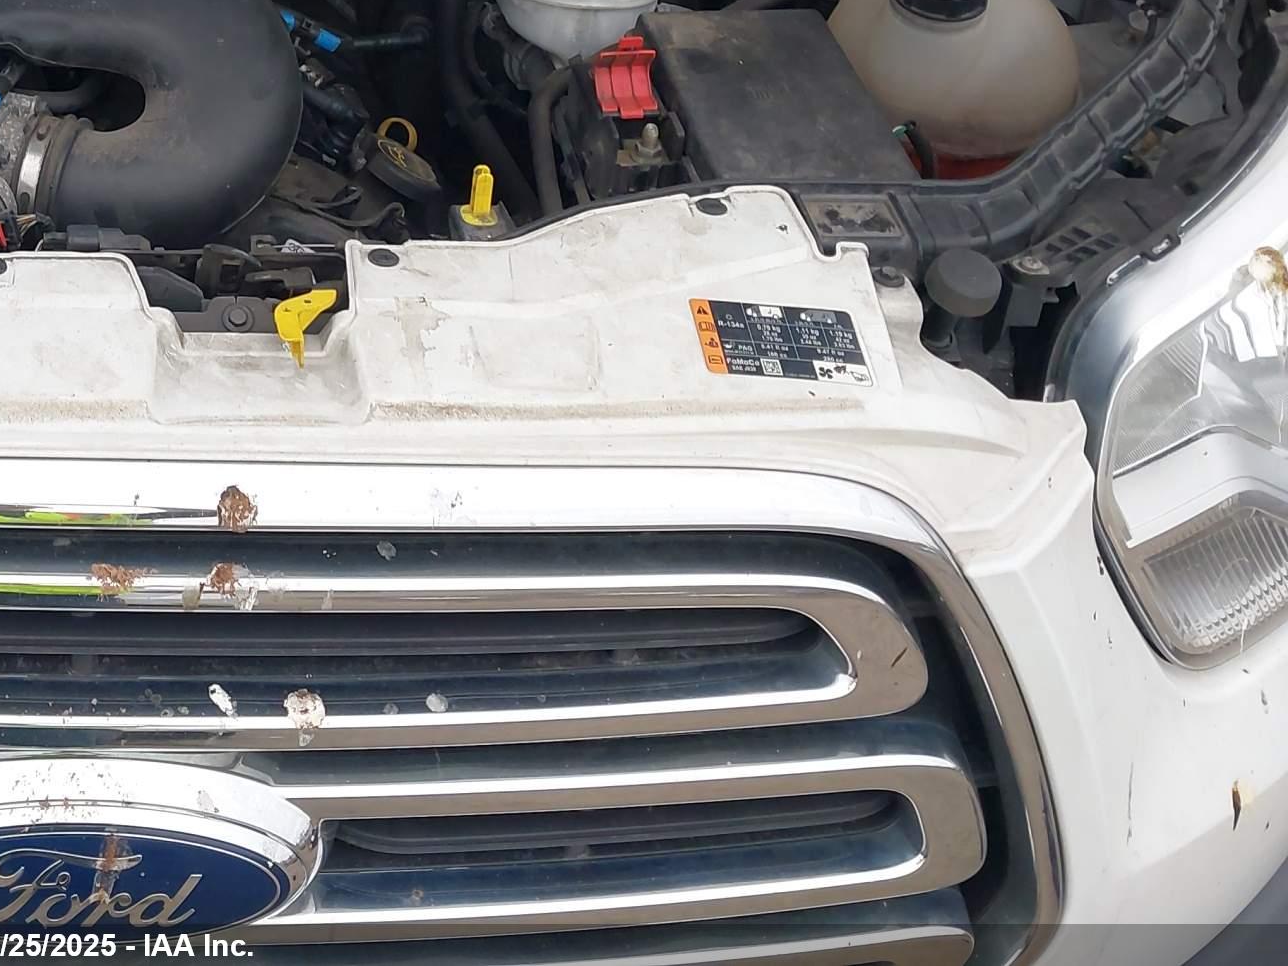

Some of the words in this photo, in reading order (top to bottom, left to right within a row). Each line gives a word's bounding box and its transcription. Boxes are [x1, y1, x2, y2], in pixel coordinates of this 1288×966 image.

[717, 320, 745, 329] R-134a
[772, 325, 781, 333] kg
[727, 357, 760, 366] FoMoCo
